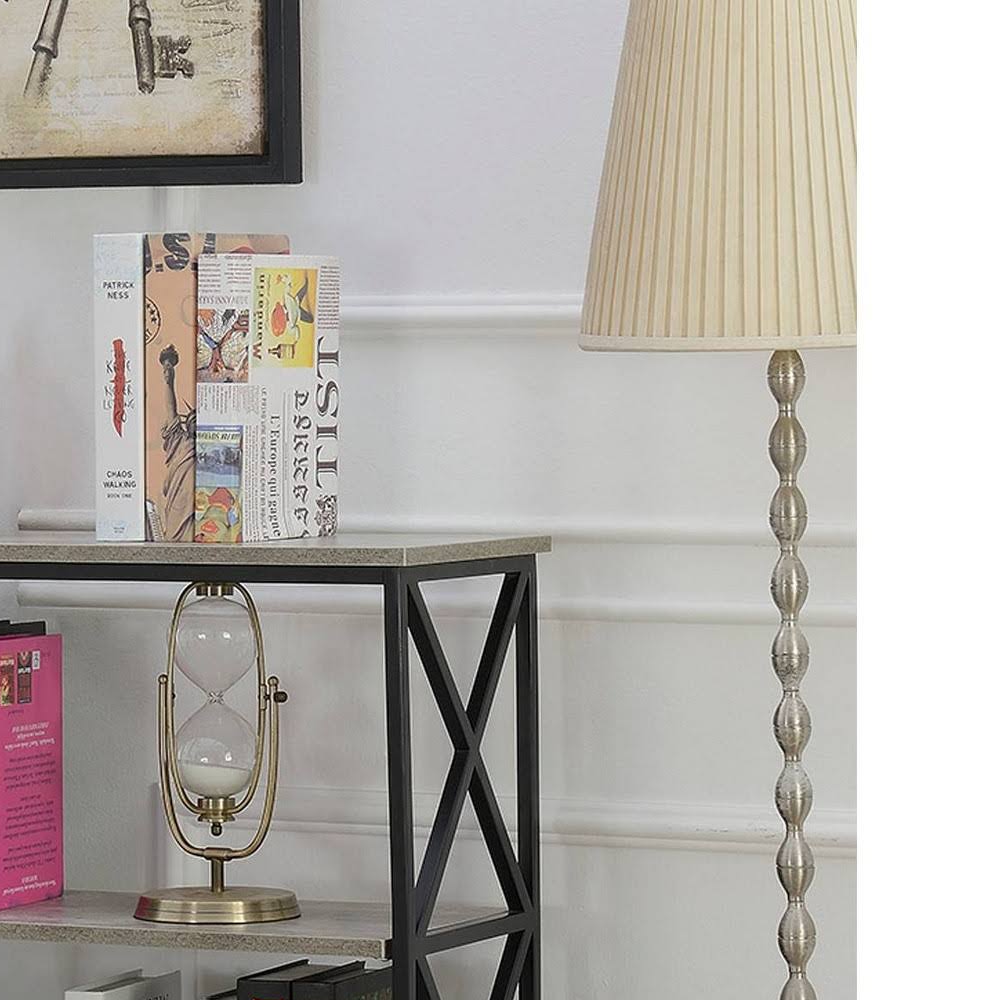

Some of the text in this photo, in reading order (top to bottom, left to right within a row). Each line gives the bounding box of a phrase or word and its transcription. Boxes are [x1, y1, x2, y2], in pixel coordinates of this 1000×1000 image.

[103, 281, 134, 289] PATRICK
[108, 291, 129, 300] NESS
[106, 470, 133, 478] CHAOS
[269, 478, 280, 497] qui
[267, 501, 281, 537] gagne
